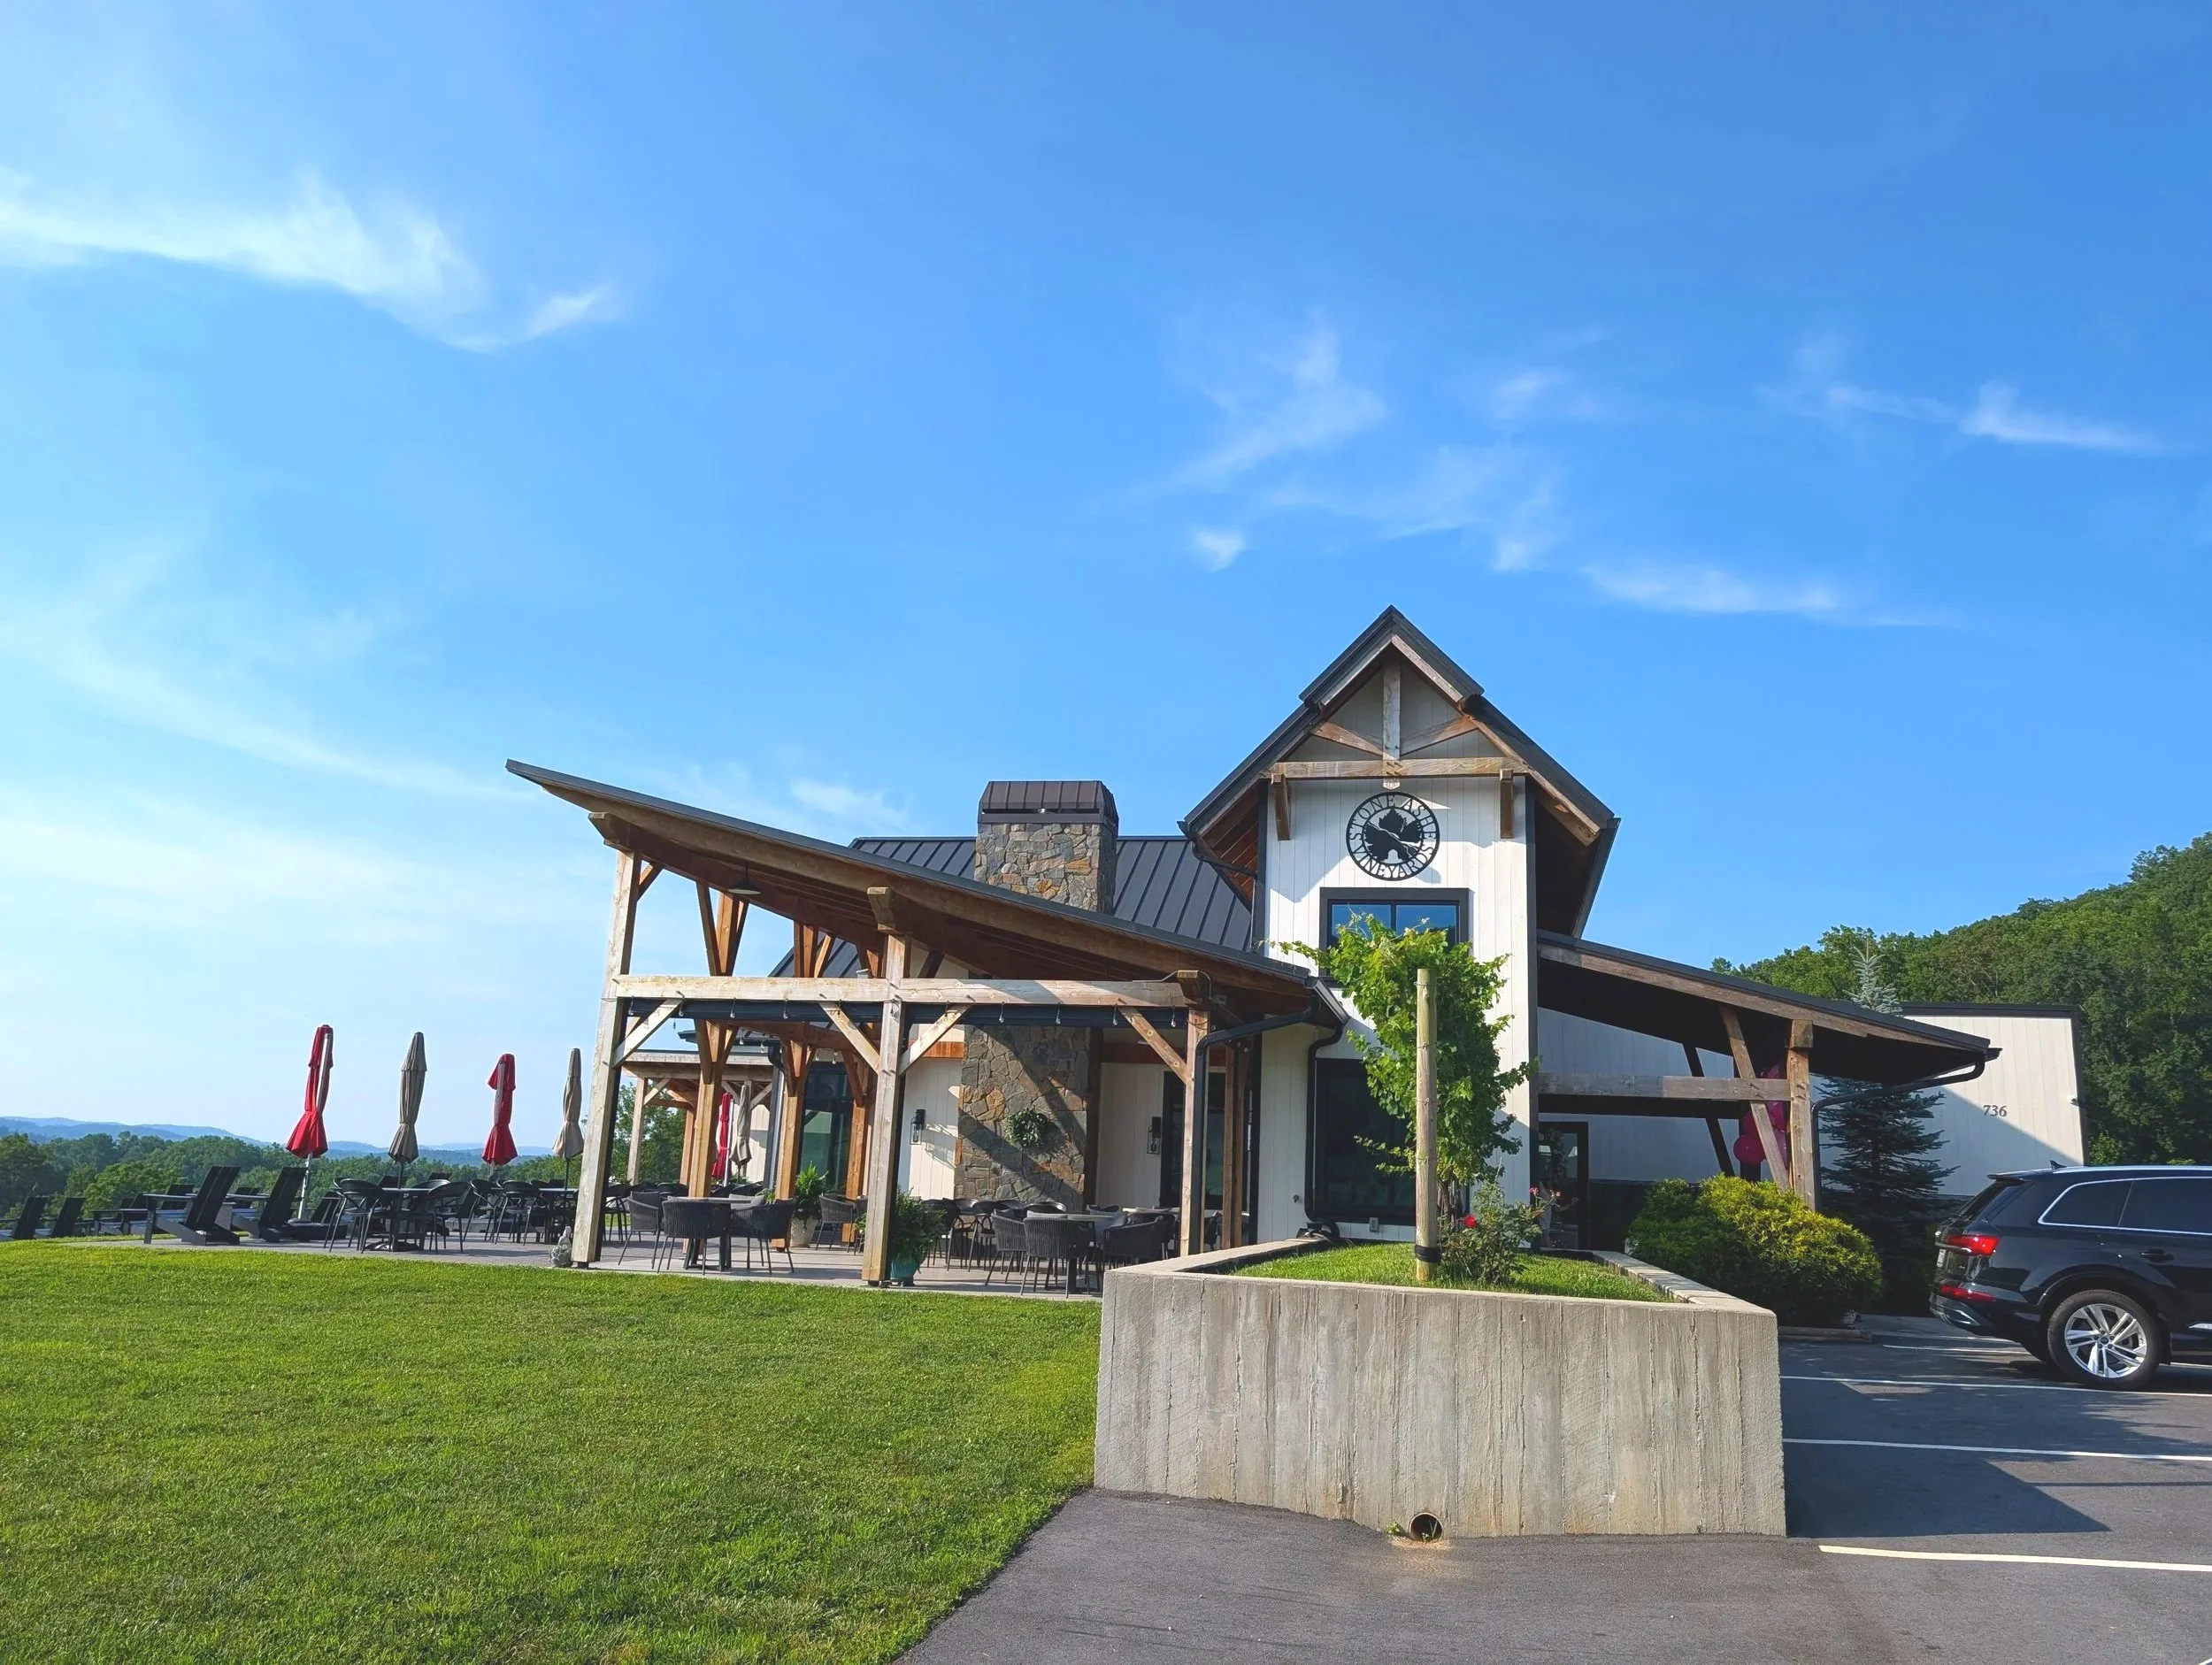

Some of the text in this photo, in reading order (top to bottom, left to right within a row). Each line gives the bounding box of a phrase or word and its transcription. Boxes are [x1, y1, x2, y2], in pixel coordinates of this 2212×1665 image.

[1349, 794, 1437, 841] STONE ASHE
[1352, 843, 1434, 879] VINEYARDS
[1983, 1104, 2008, 1117] 736
